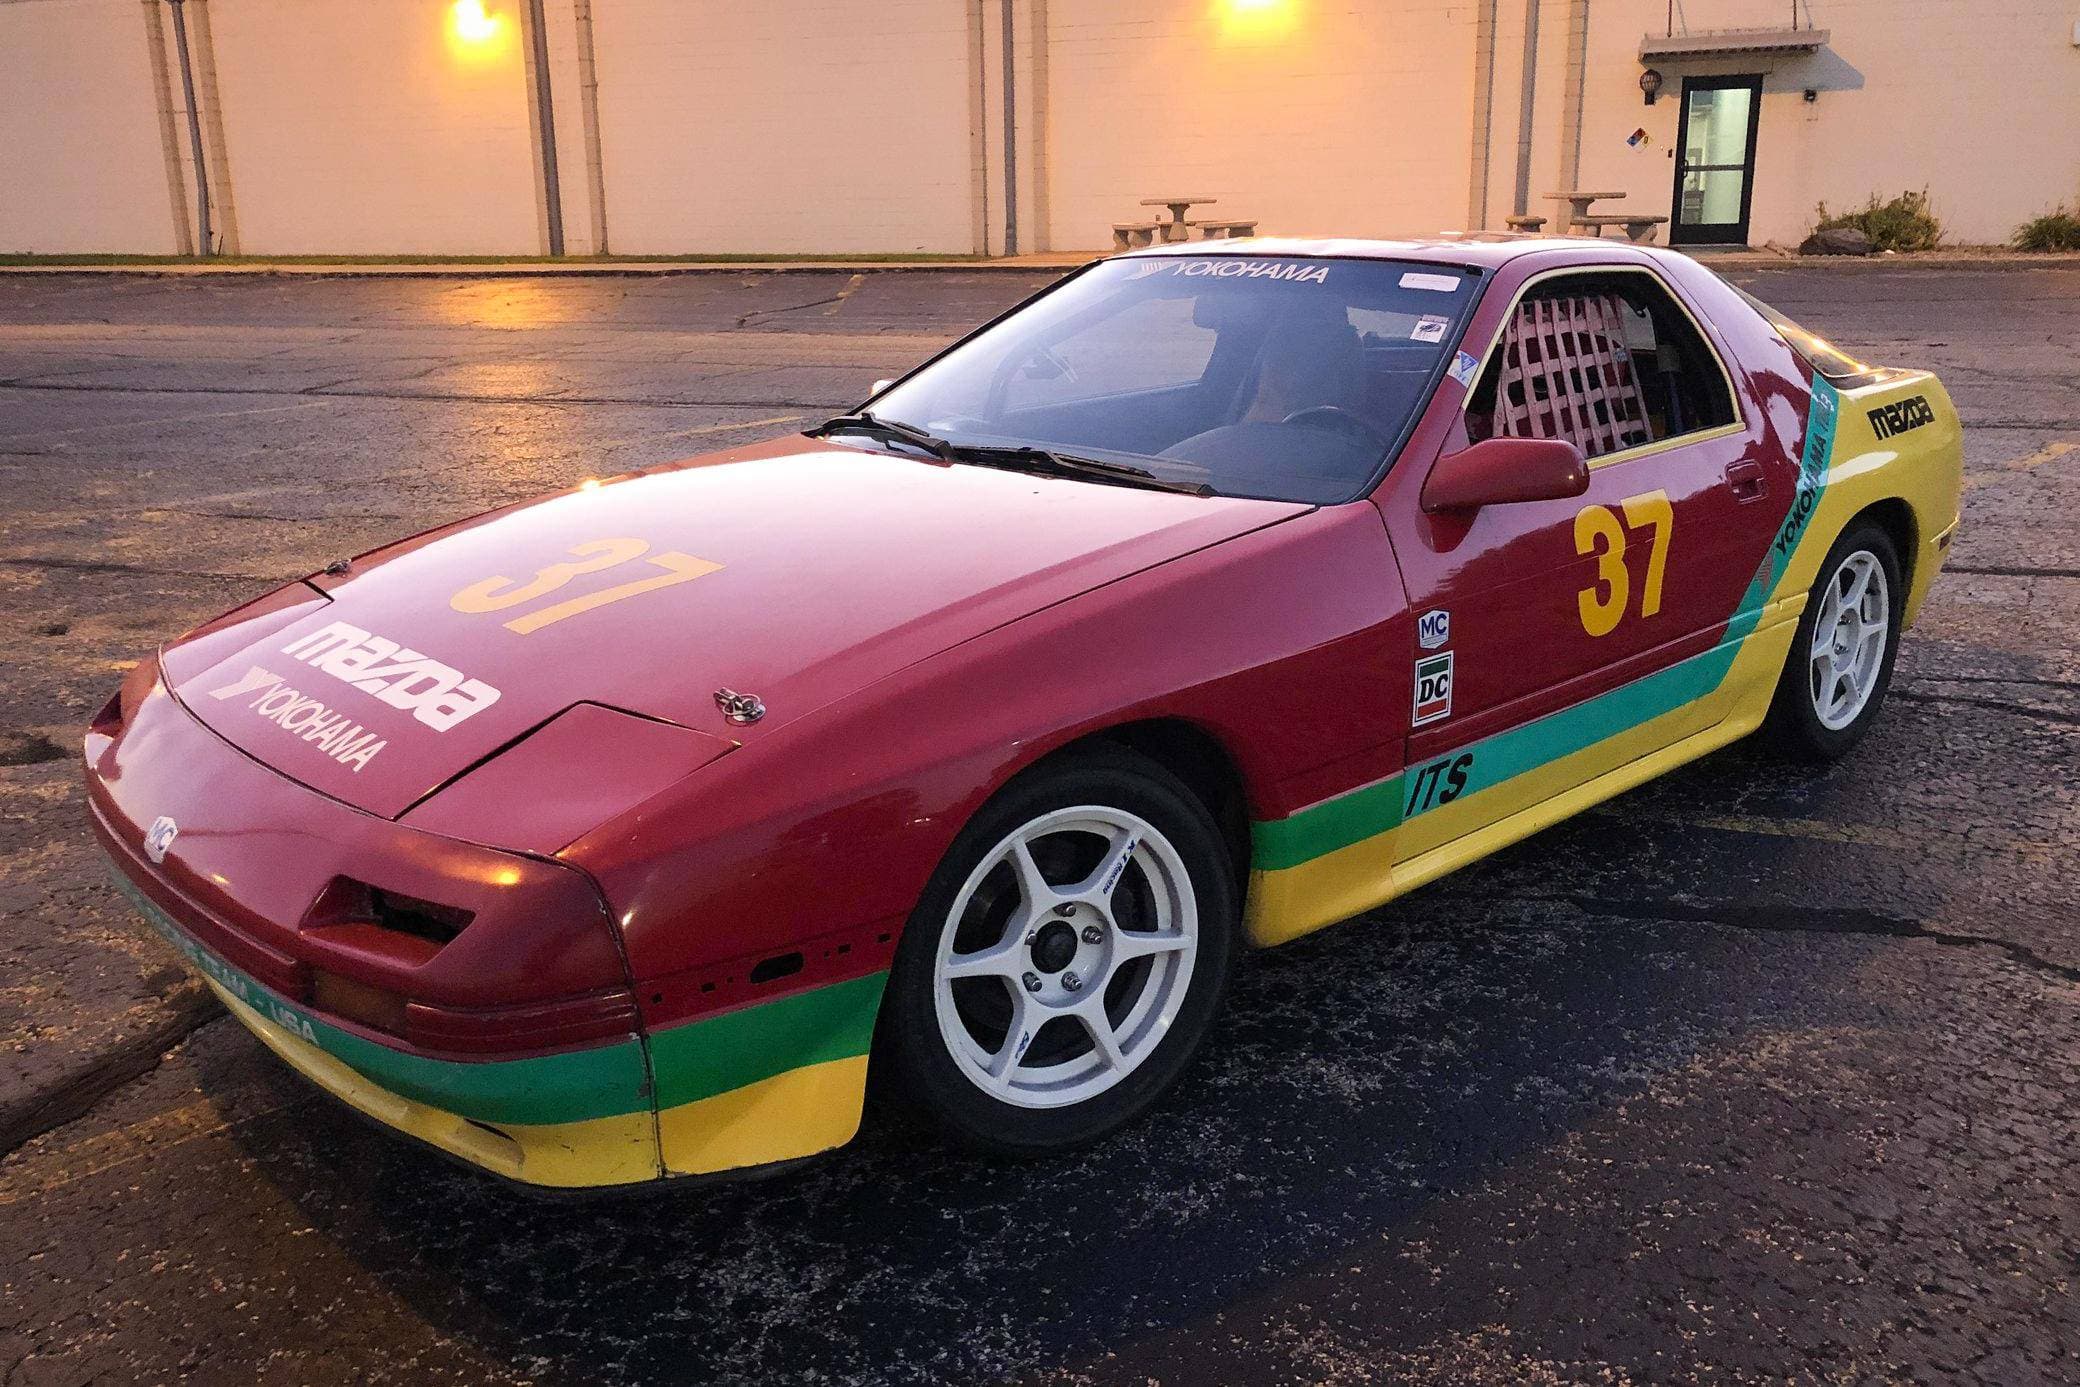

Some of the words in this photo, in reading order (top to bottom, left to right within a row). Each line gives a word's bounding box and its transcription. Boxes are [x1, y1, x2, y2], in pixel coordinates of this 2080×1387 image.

[1173, 261, 1330, 285] YOKOHAMA
[1867, 395, 1936, 440] mazda
[1776, 433, 1827, 556] YOKOHAMA
[449, 537, 727, 636] 37
[1574, 488, 1674, 637] 37
[1421, 613, 1448, 639] MC
[281, 620, 502, 733] mazda
[1418, 673, 1448, 704] DC
[249, 681, 388, 773] YOKOHAMA
[1404, 752, 1474, 818] ITS
